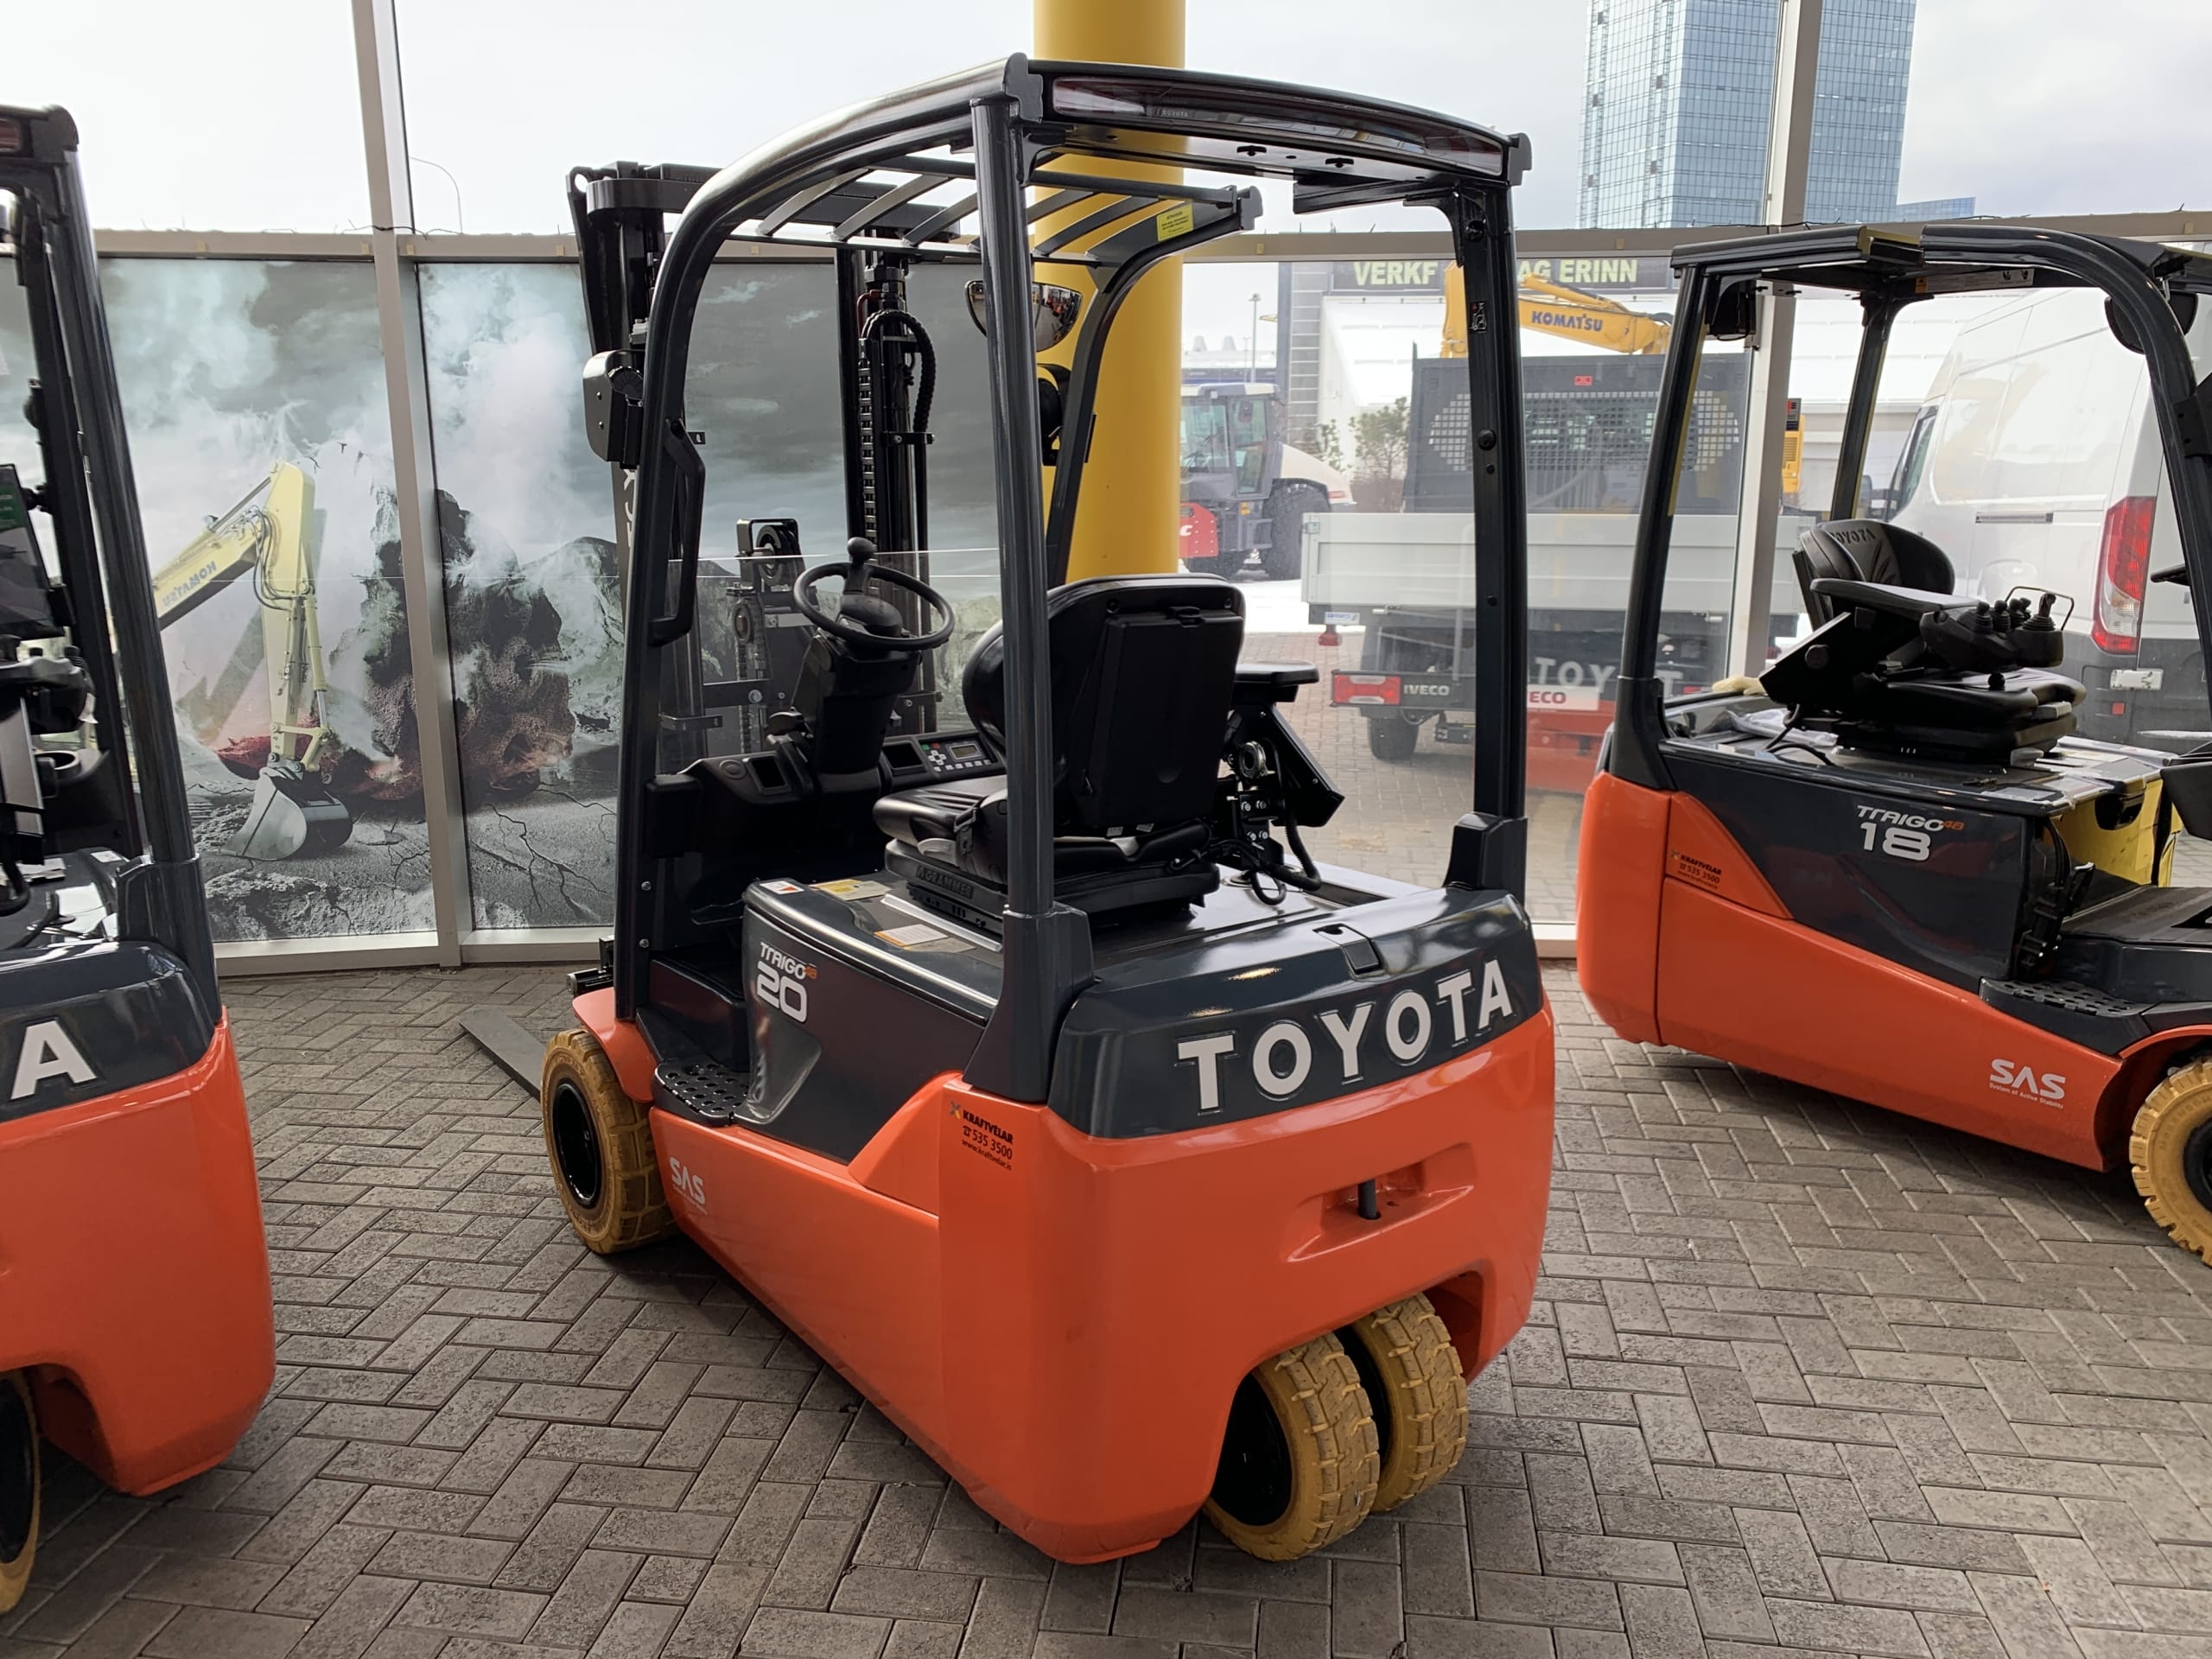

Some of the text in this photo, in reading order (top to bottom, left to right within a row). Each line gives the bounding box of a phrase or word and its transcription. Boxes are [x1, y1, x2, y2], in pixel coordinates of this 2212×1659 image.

[1560, 259, 1637, 283] ERINN
[1531, 310, 1604, 332] KOMATSU
[1403, 684, 1450, 696] IVECO
[1860, 822, 1931, 861] 18
[925, 869, 972, 899] GRAMMER
[757, 960, 807, 1023] 20
[1177, 958, 1514, 1110] TOYOTA
[10, 1020, 97, 1100] A
[1990, 1058, 2066, 1099] SAS
[972, 1128, 1013, 1160] 535 3500
[670, 1157, 706, 1205] SAS
